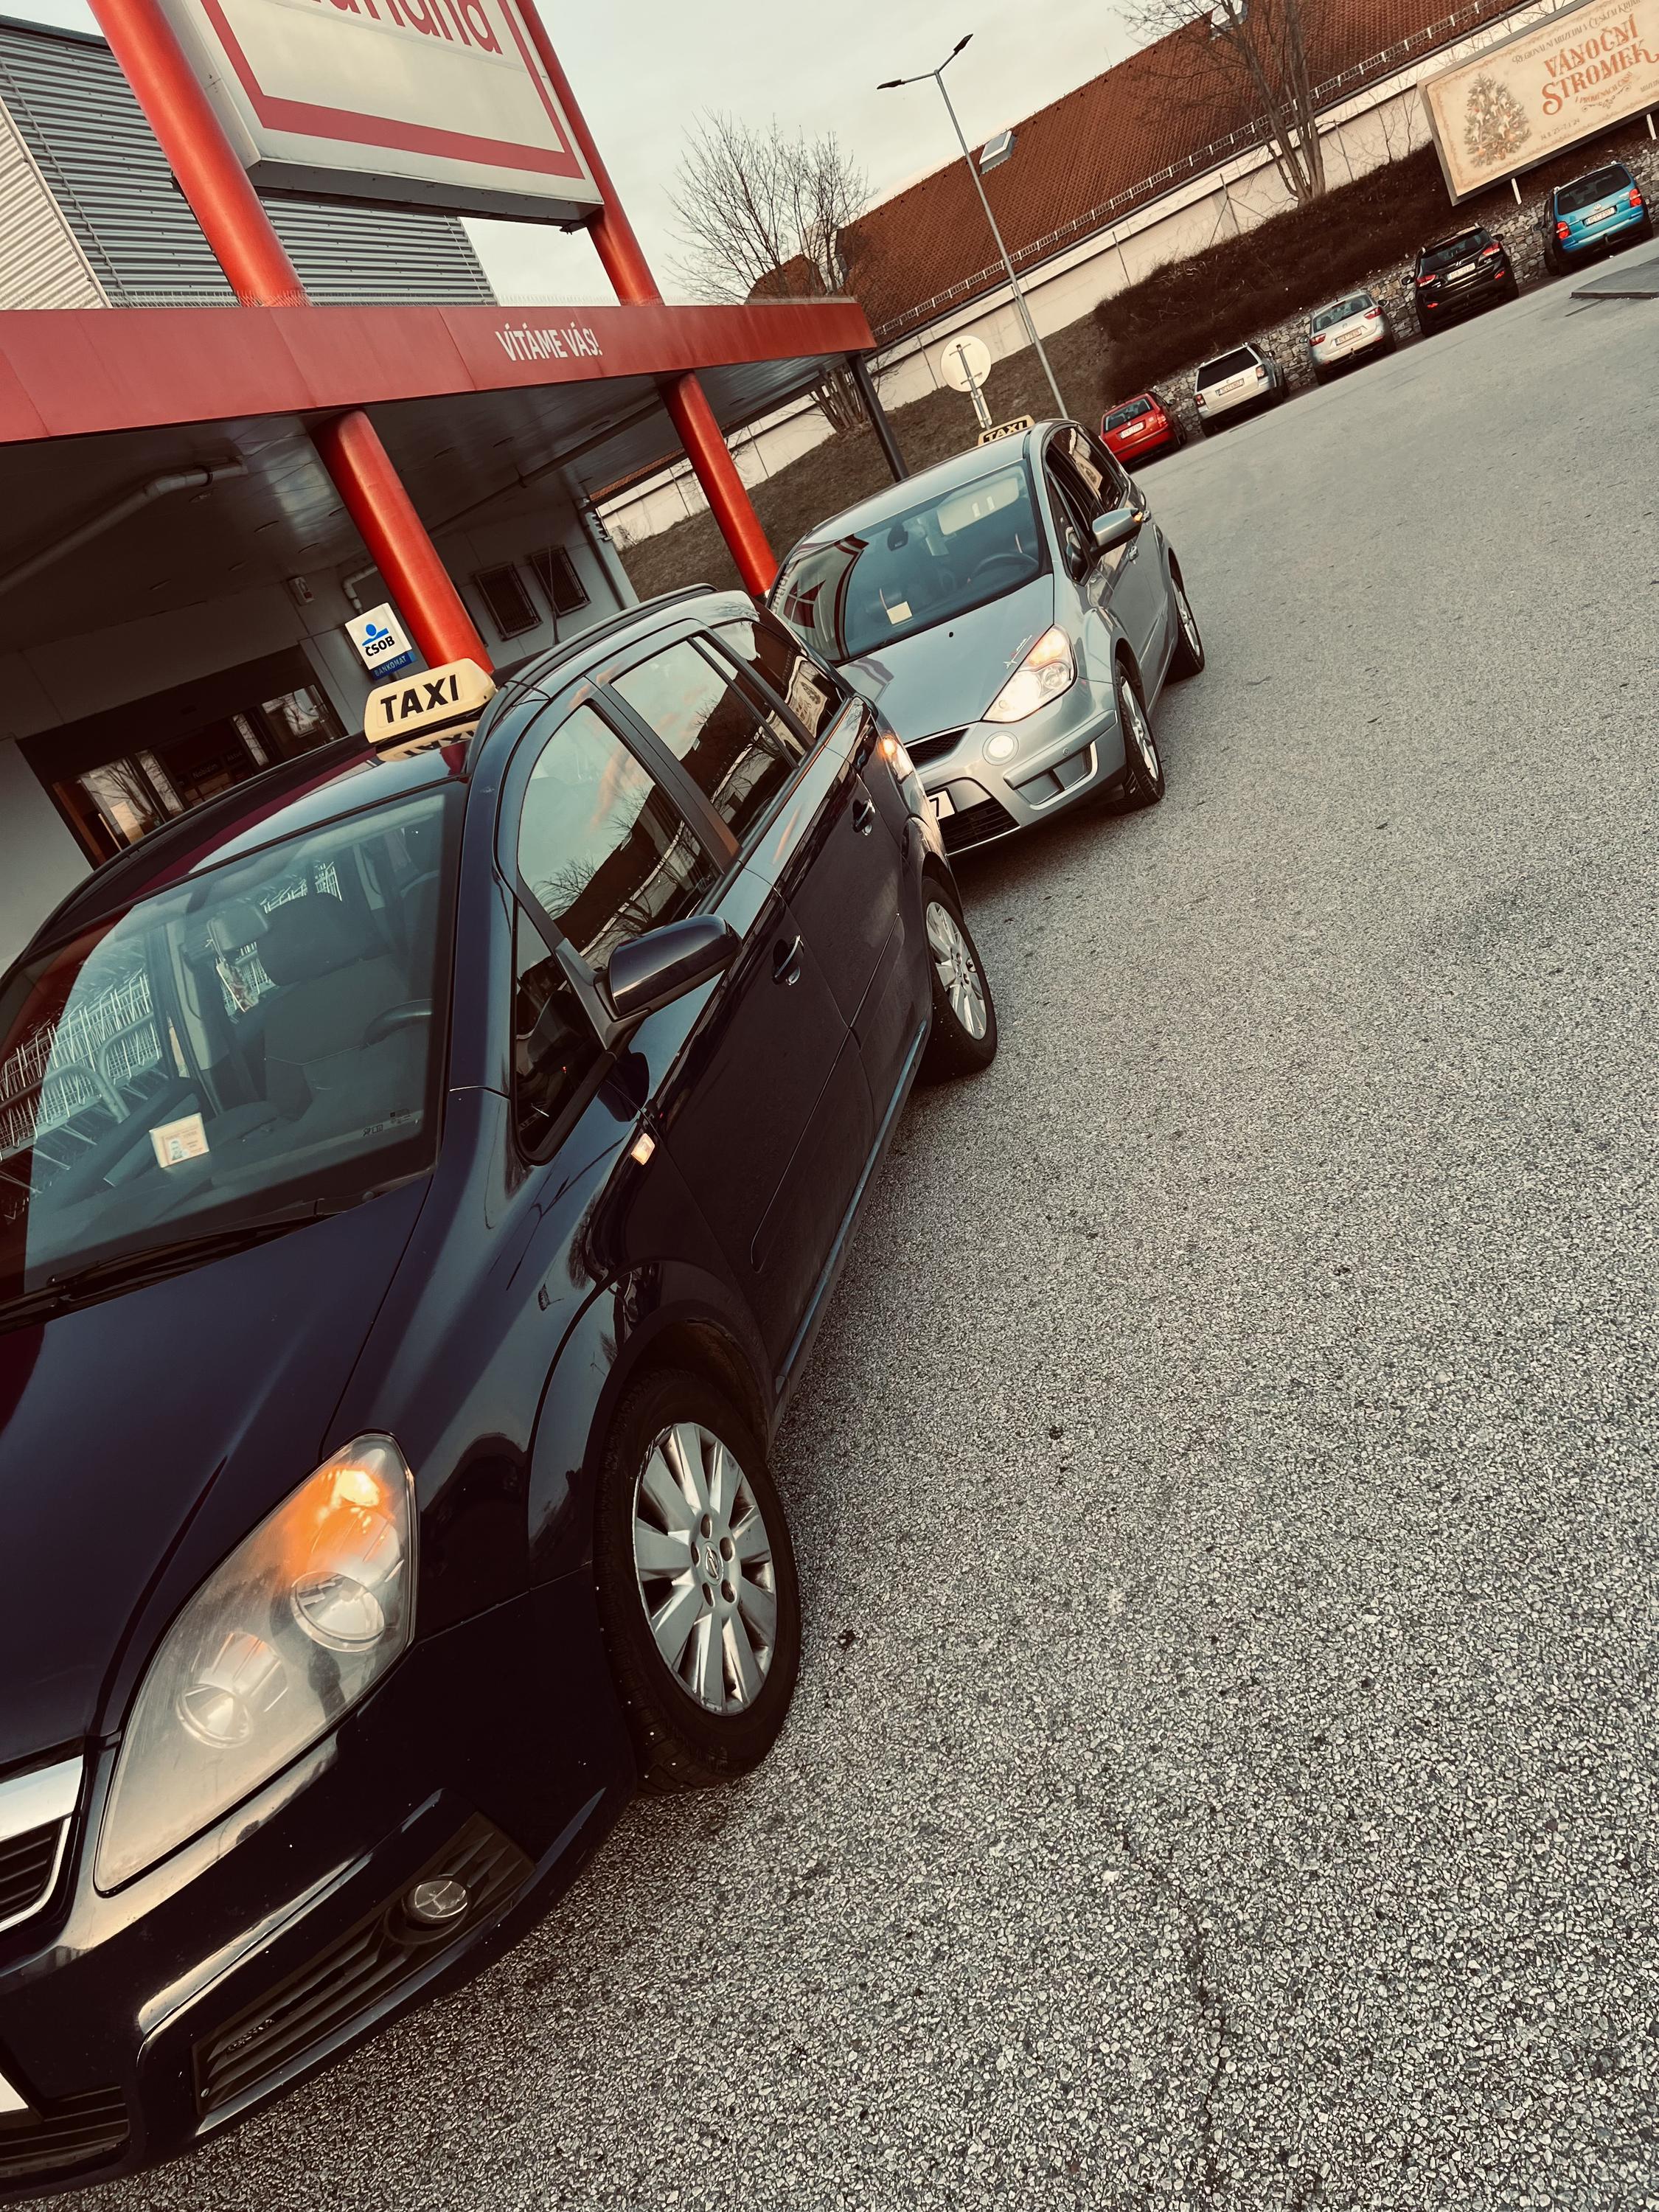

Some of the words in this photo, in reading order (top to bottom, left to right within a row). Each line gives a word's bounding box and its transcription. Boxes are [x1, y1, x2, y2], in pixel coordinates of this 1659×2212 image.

[1544, 13, 1638, 78] VÁNOČNÍ
[1542, 38, 1659, 115] STROMEK
[495, 322, 568, 361] VÍTÁME
[560, 321, 603, 357] VÁS!
[985, 422, 1024, 442] TAXI
[365, 636, 395, 657] ČSOB
[374, 655, 407, 677] BANKOMAT
[380, 674, 459, 724] TAXI
